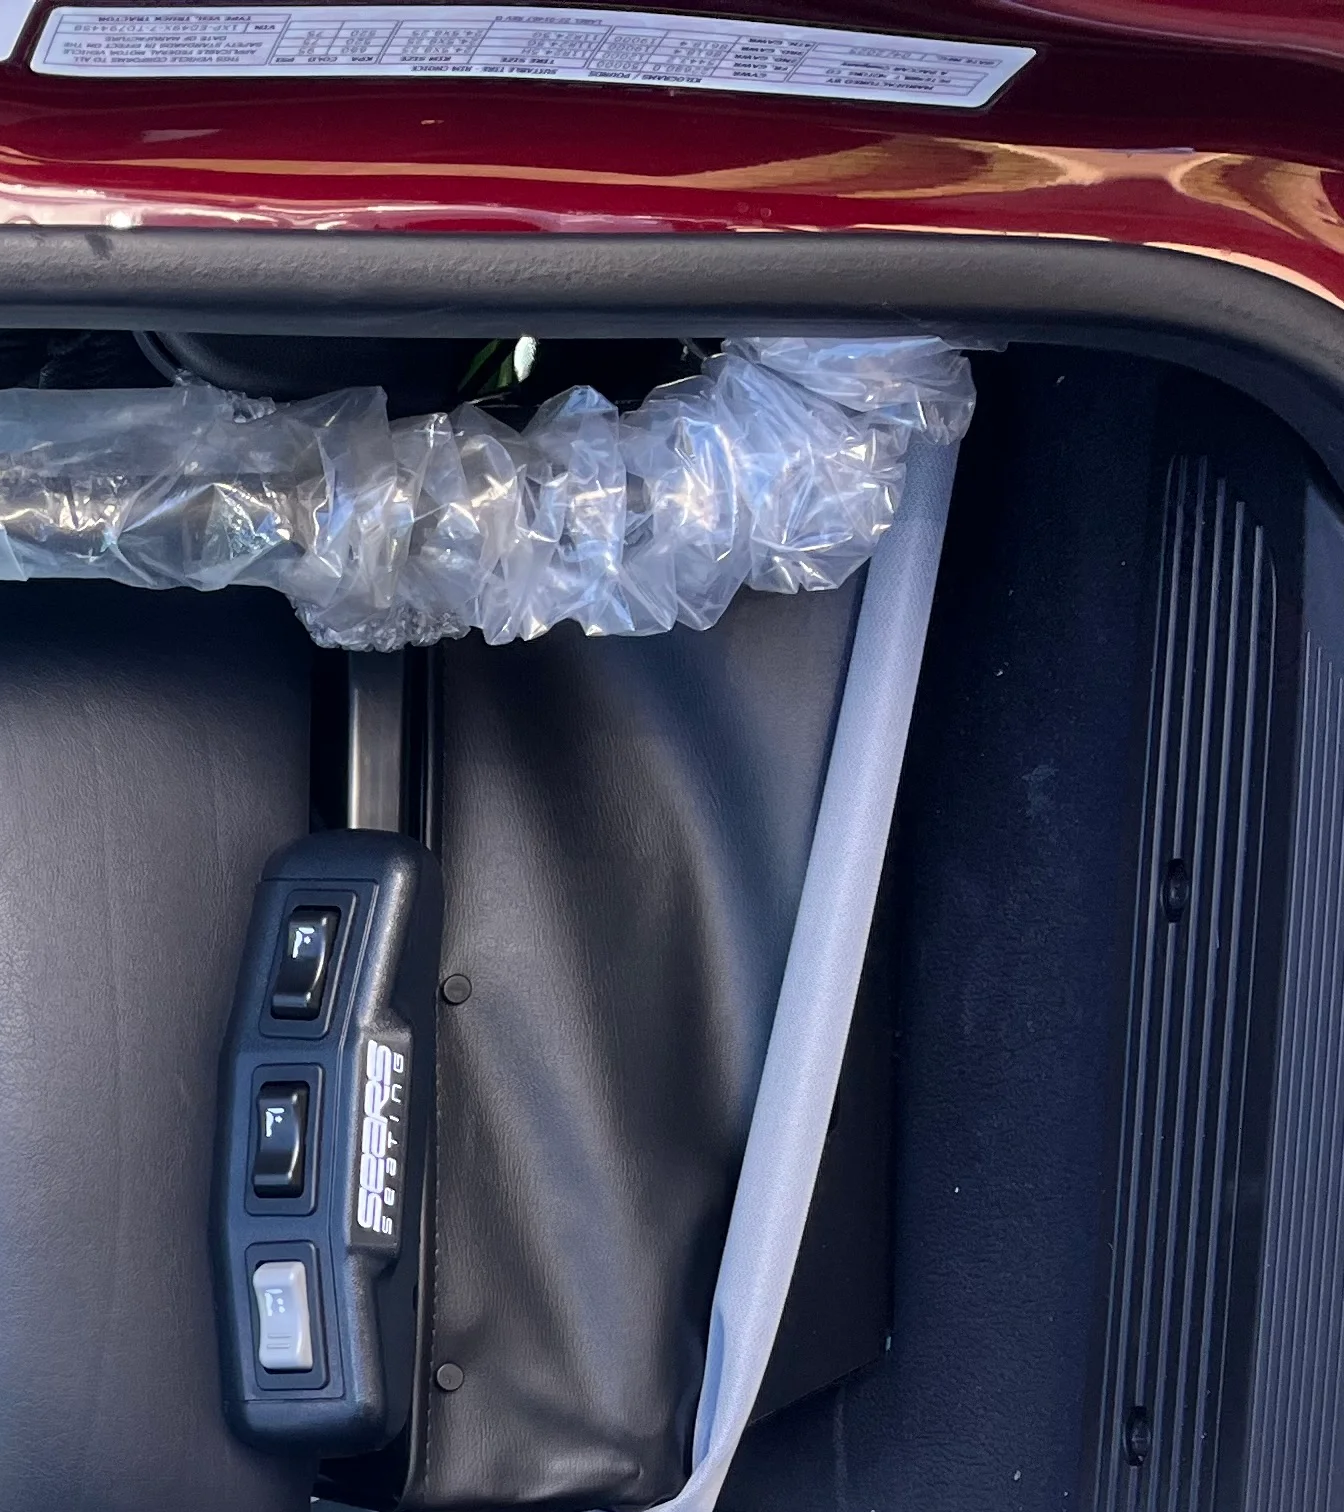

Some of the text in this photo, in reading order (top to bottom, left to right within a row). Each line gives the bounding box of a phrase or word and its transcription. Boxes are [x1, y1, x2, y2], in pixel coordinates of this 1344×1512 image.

[596, 60, 639, 71] 50000
[588, 71, 631, 79] POUNDS
[641, 74, 702, 83] KILOGRAMS
[356, 1039, 393, 1232] SEARS
[381, 1052, 405, 1236] SEATING
